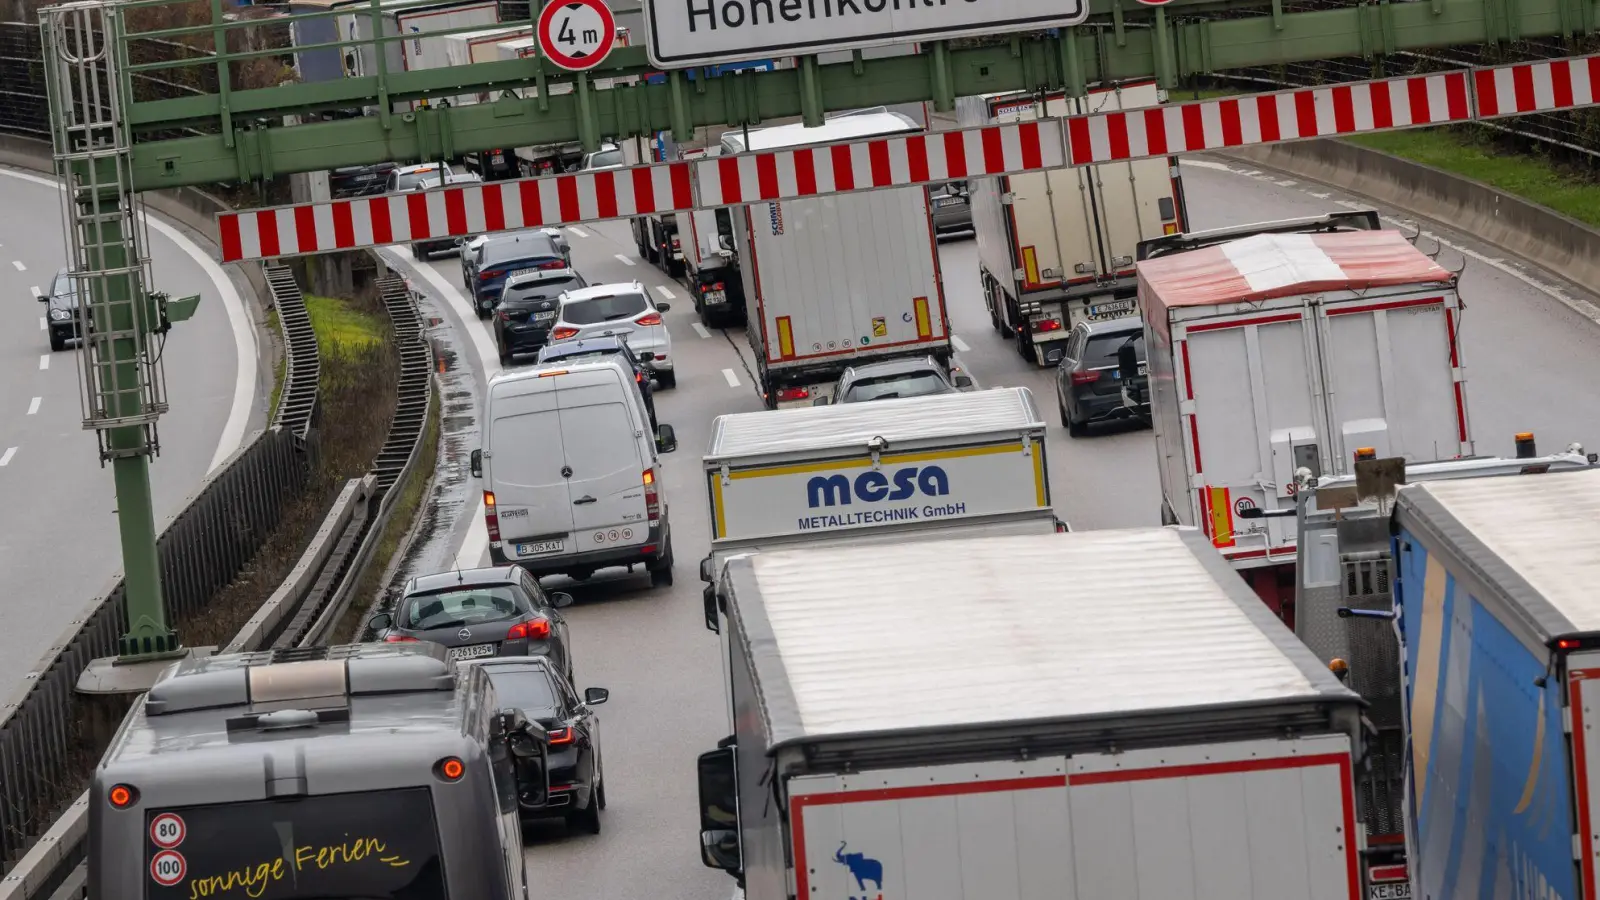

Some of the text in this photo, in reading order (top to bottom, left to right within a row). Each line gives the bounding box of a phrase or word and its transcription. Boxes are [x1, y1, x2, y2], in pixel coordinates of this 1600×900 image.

[558, 17, 598, 45] 4 m
[769, 202, 778, 236] SCHMIT
[807, 465, 949, 508] mesa
[798, 502, 966, 530] METALLTECHNIK GmbH
[521, 541, 561, 554] B 305 KAT
[160, 823, 177, 837] 80
[158, 860, 180, 875] 100
[189, 832, 386, 900] sonnige Ferien
[1371, 886, 1387, 899] KE
